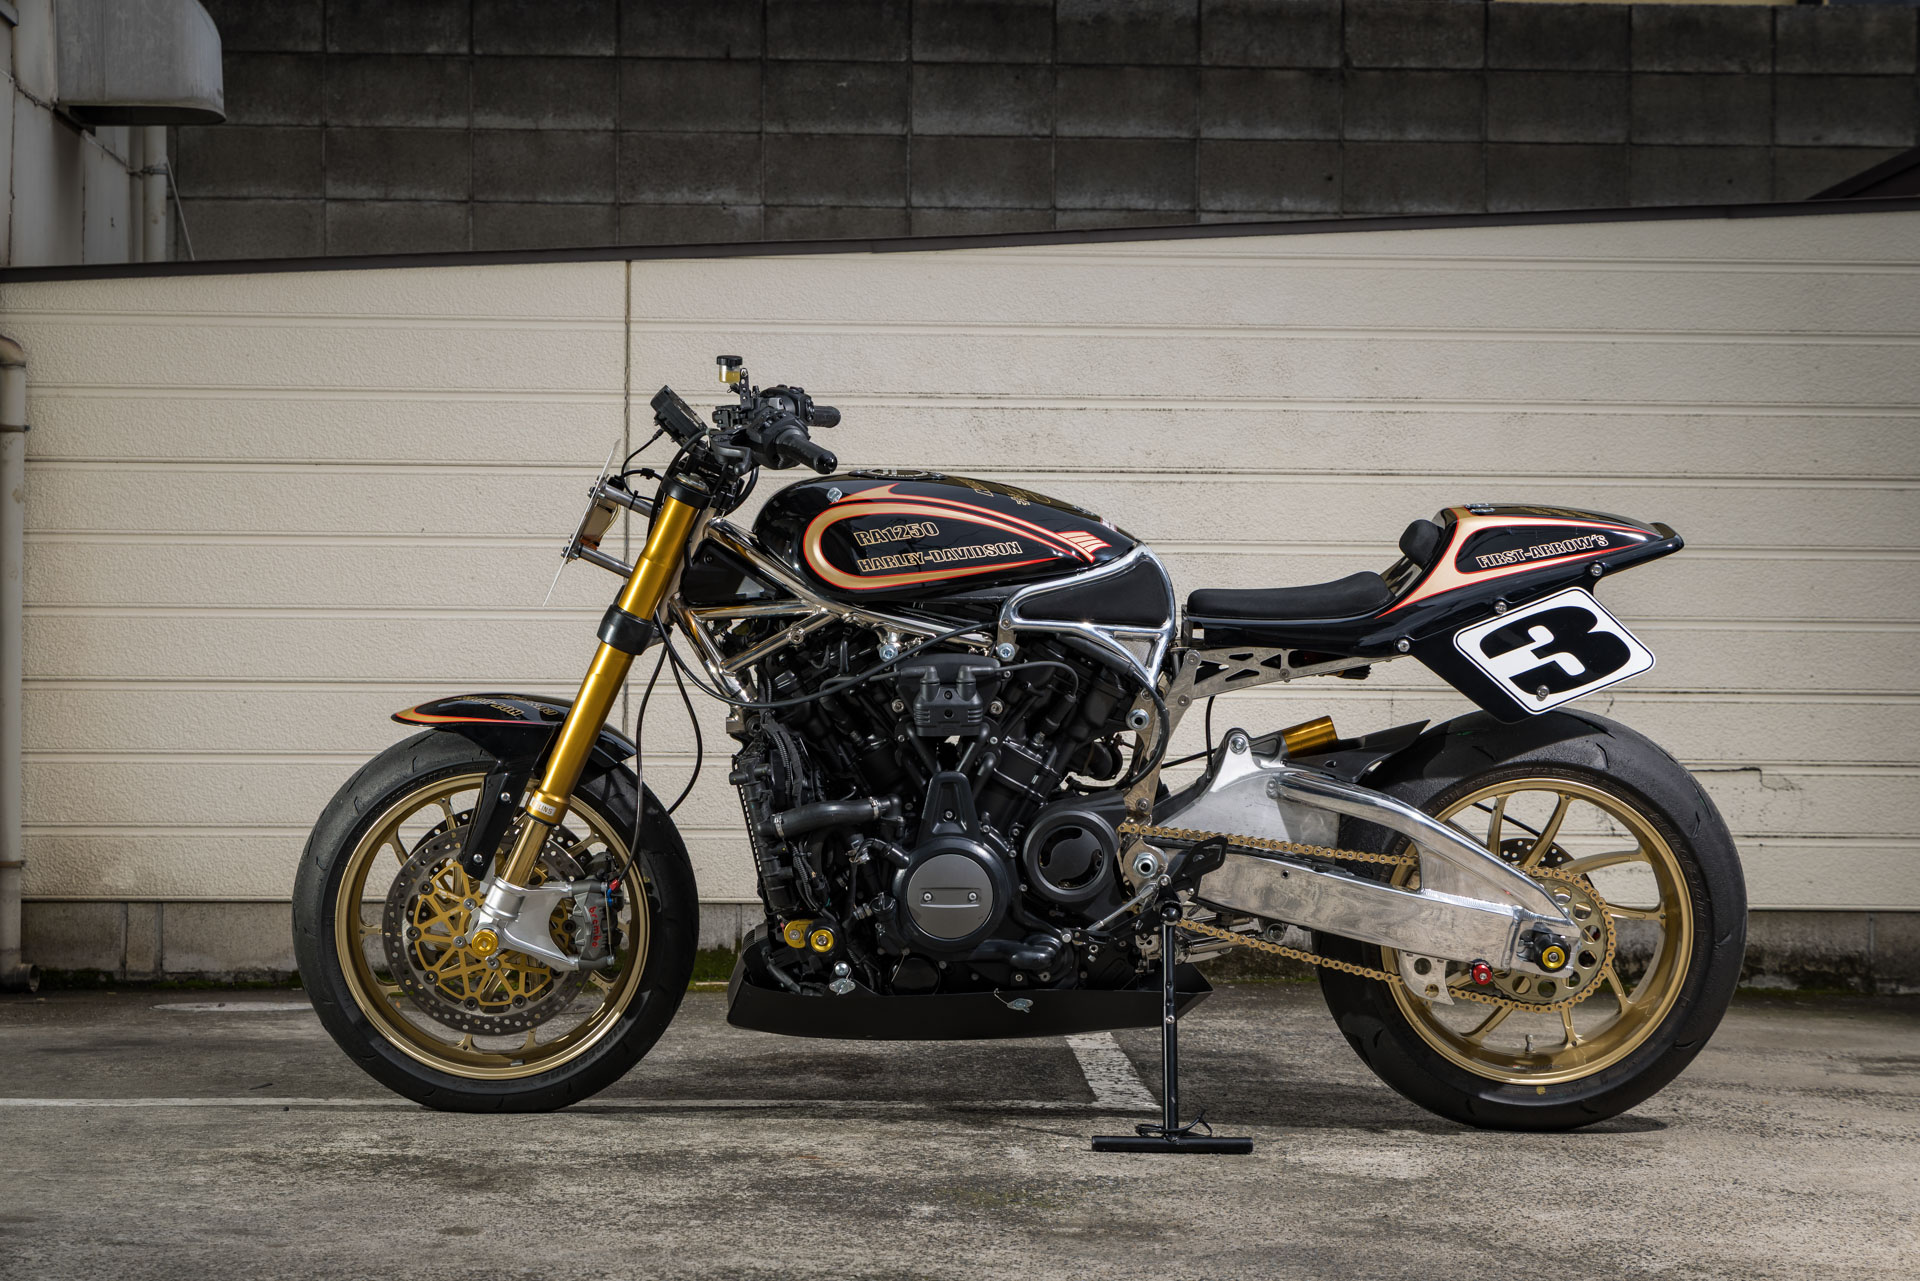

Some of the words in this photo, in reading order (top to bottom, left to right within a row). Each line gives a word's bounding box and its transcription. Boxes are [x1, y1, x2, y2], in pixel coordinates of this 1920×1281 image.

[853, 521, 940, 546] RA1250
[857, 541, 1022, 572] HARLEY-DAVIDSON
[1475, 534, 1609, 568] FIRST-ARROW'S
[1480, 605, 1631, 695] 3
[589, 906, 602, 948] brembo
